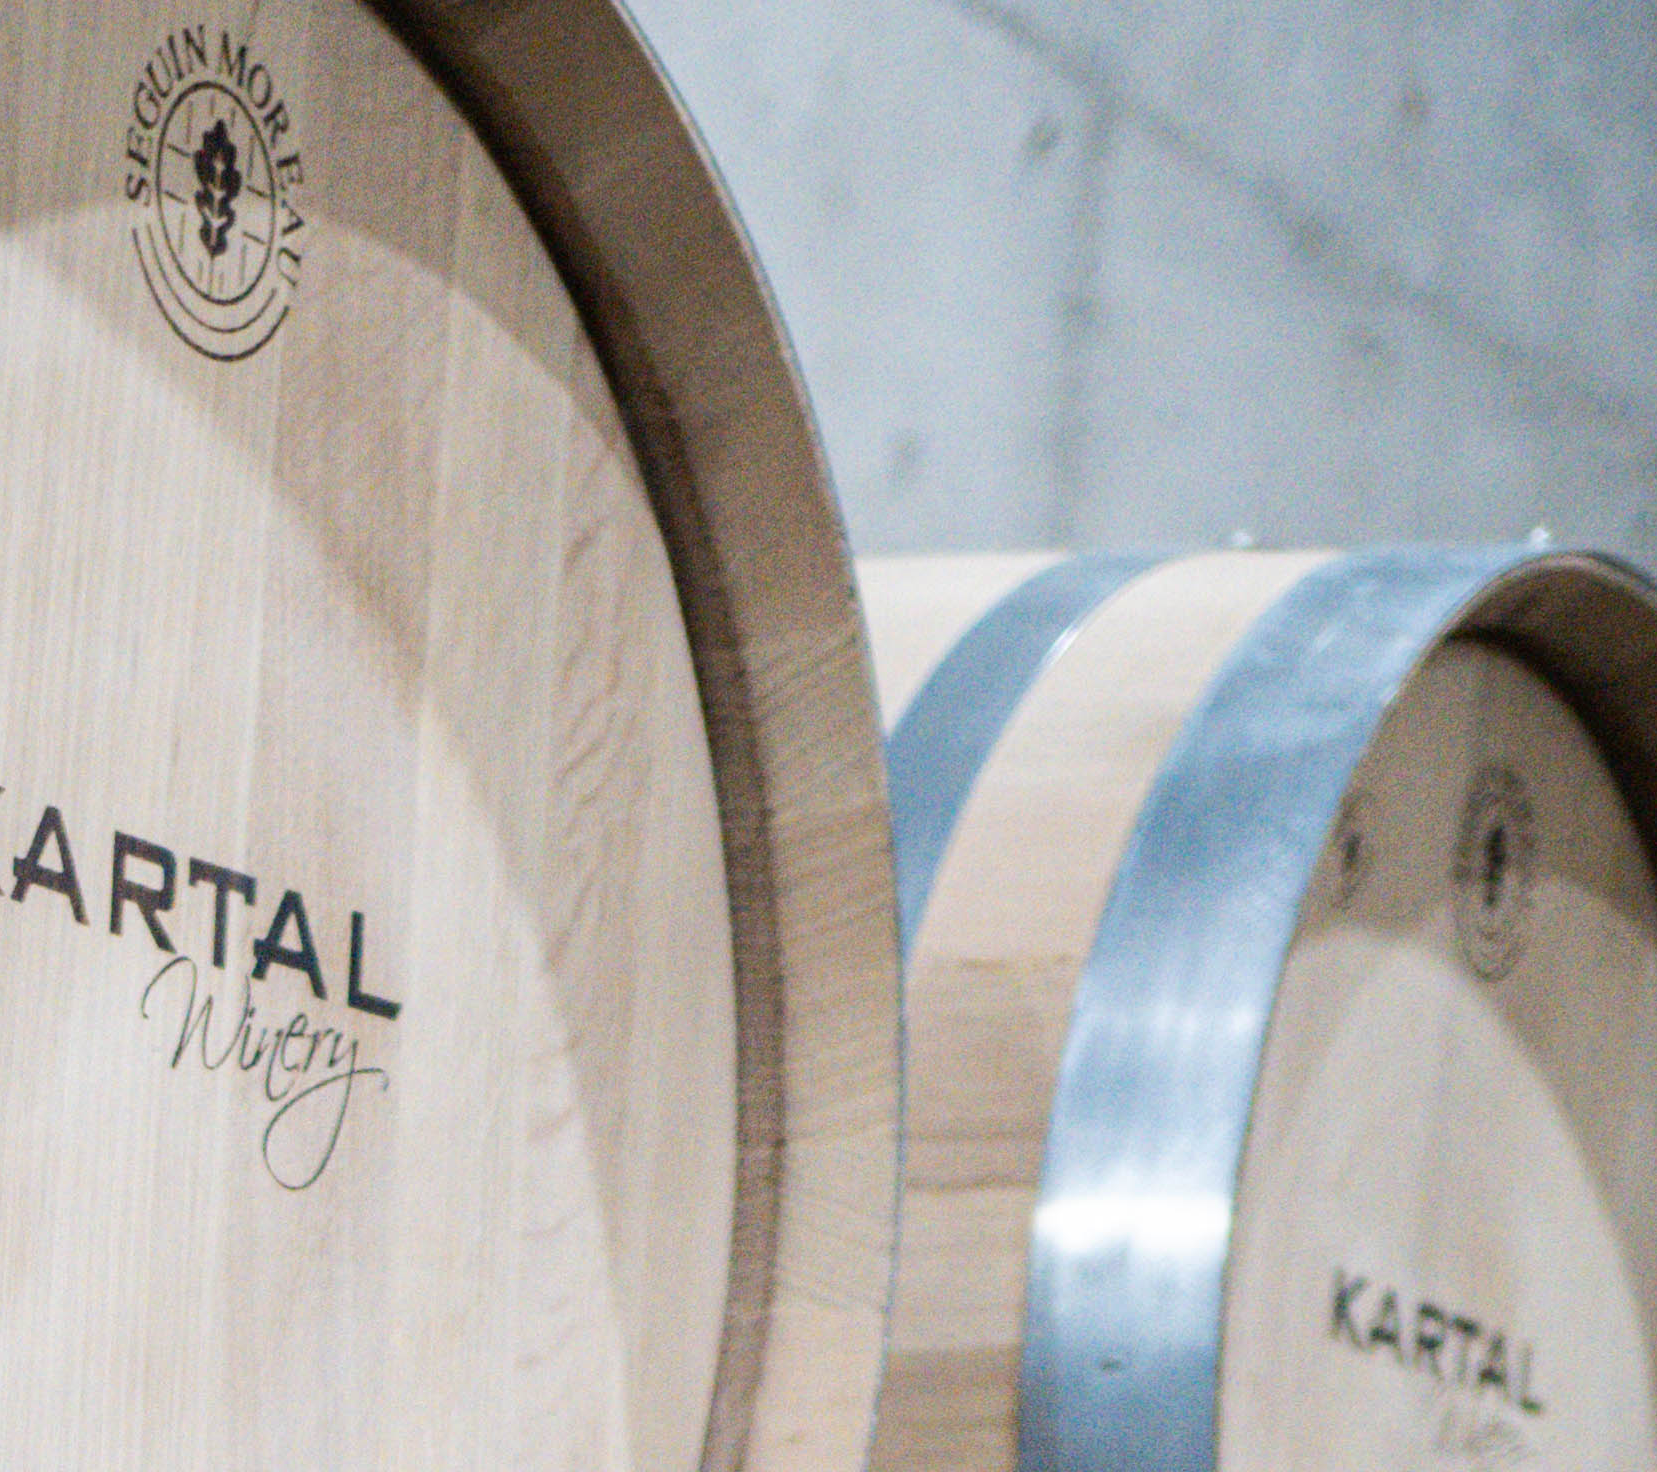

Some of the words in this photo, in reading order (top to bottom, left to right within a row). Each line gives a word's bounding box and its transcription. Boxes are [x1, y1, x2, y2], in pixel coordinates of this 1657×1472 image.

[126, 24, 207, 206] SEGUIN
[217, 30, 305, 288] MOREAU
[141, 955, 389, 1191] Winery
[1329, 1268, 1544, 1416] KARTAL
